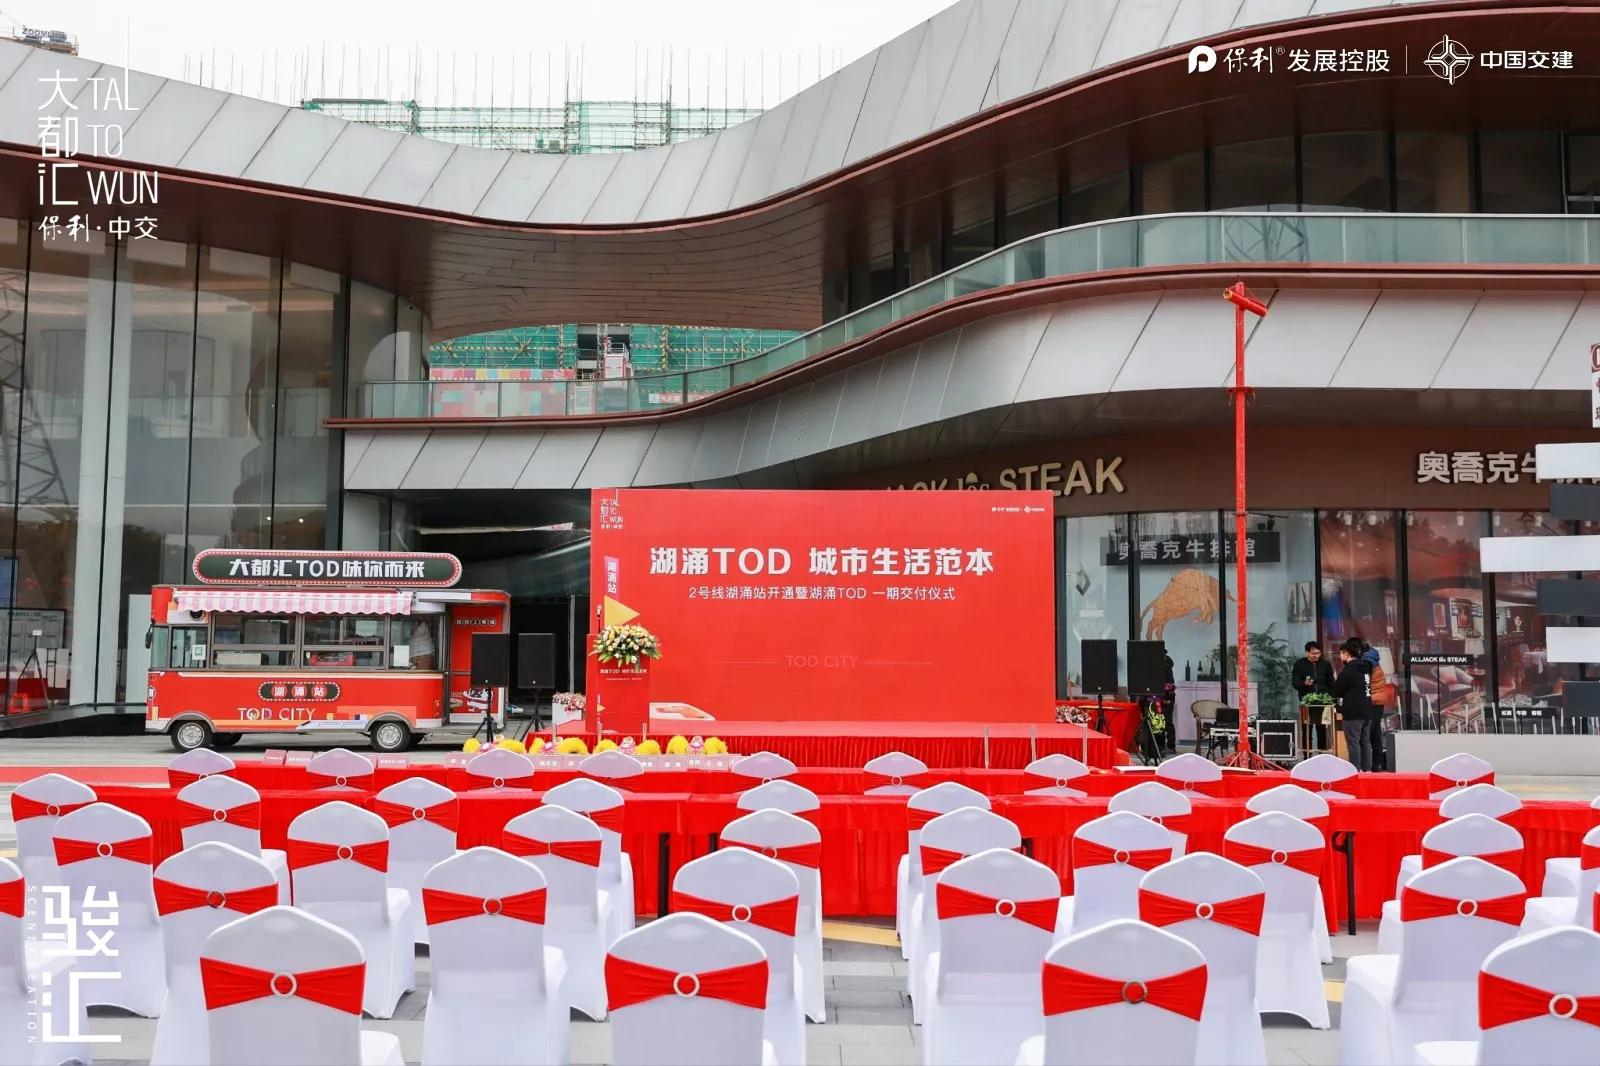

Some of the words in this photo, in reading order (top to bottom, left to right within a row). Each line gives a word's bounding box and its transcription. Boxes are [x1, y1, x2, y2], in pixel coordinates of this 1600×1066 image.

[1000, 457, 1124, 496] STEAK
[649, 547, 792, 575] 湖涌TOD
[809, 547, 994, 576] 城市生活范本
[688, 586, 867, 600] 2号线湖涌站开通暨湖涌TOD
[872, 586, 956, 600] 一期交付仪式
[786, 655, 819, 668] TOD
[824, 655, 858, 668] CITY
[238, 707, 272, 720] TOD
[279, 707, 316, 720] CITY
